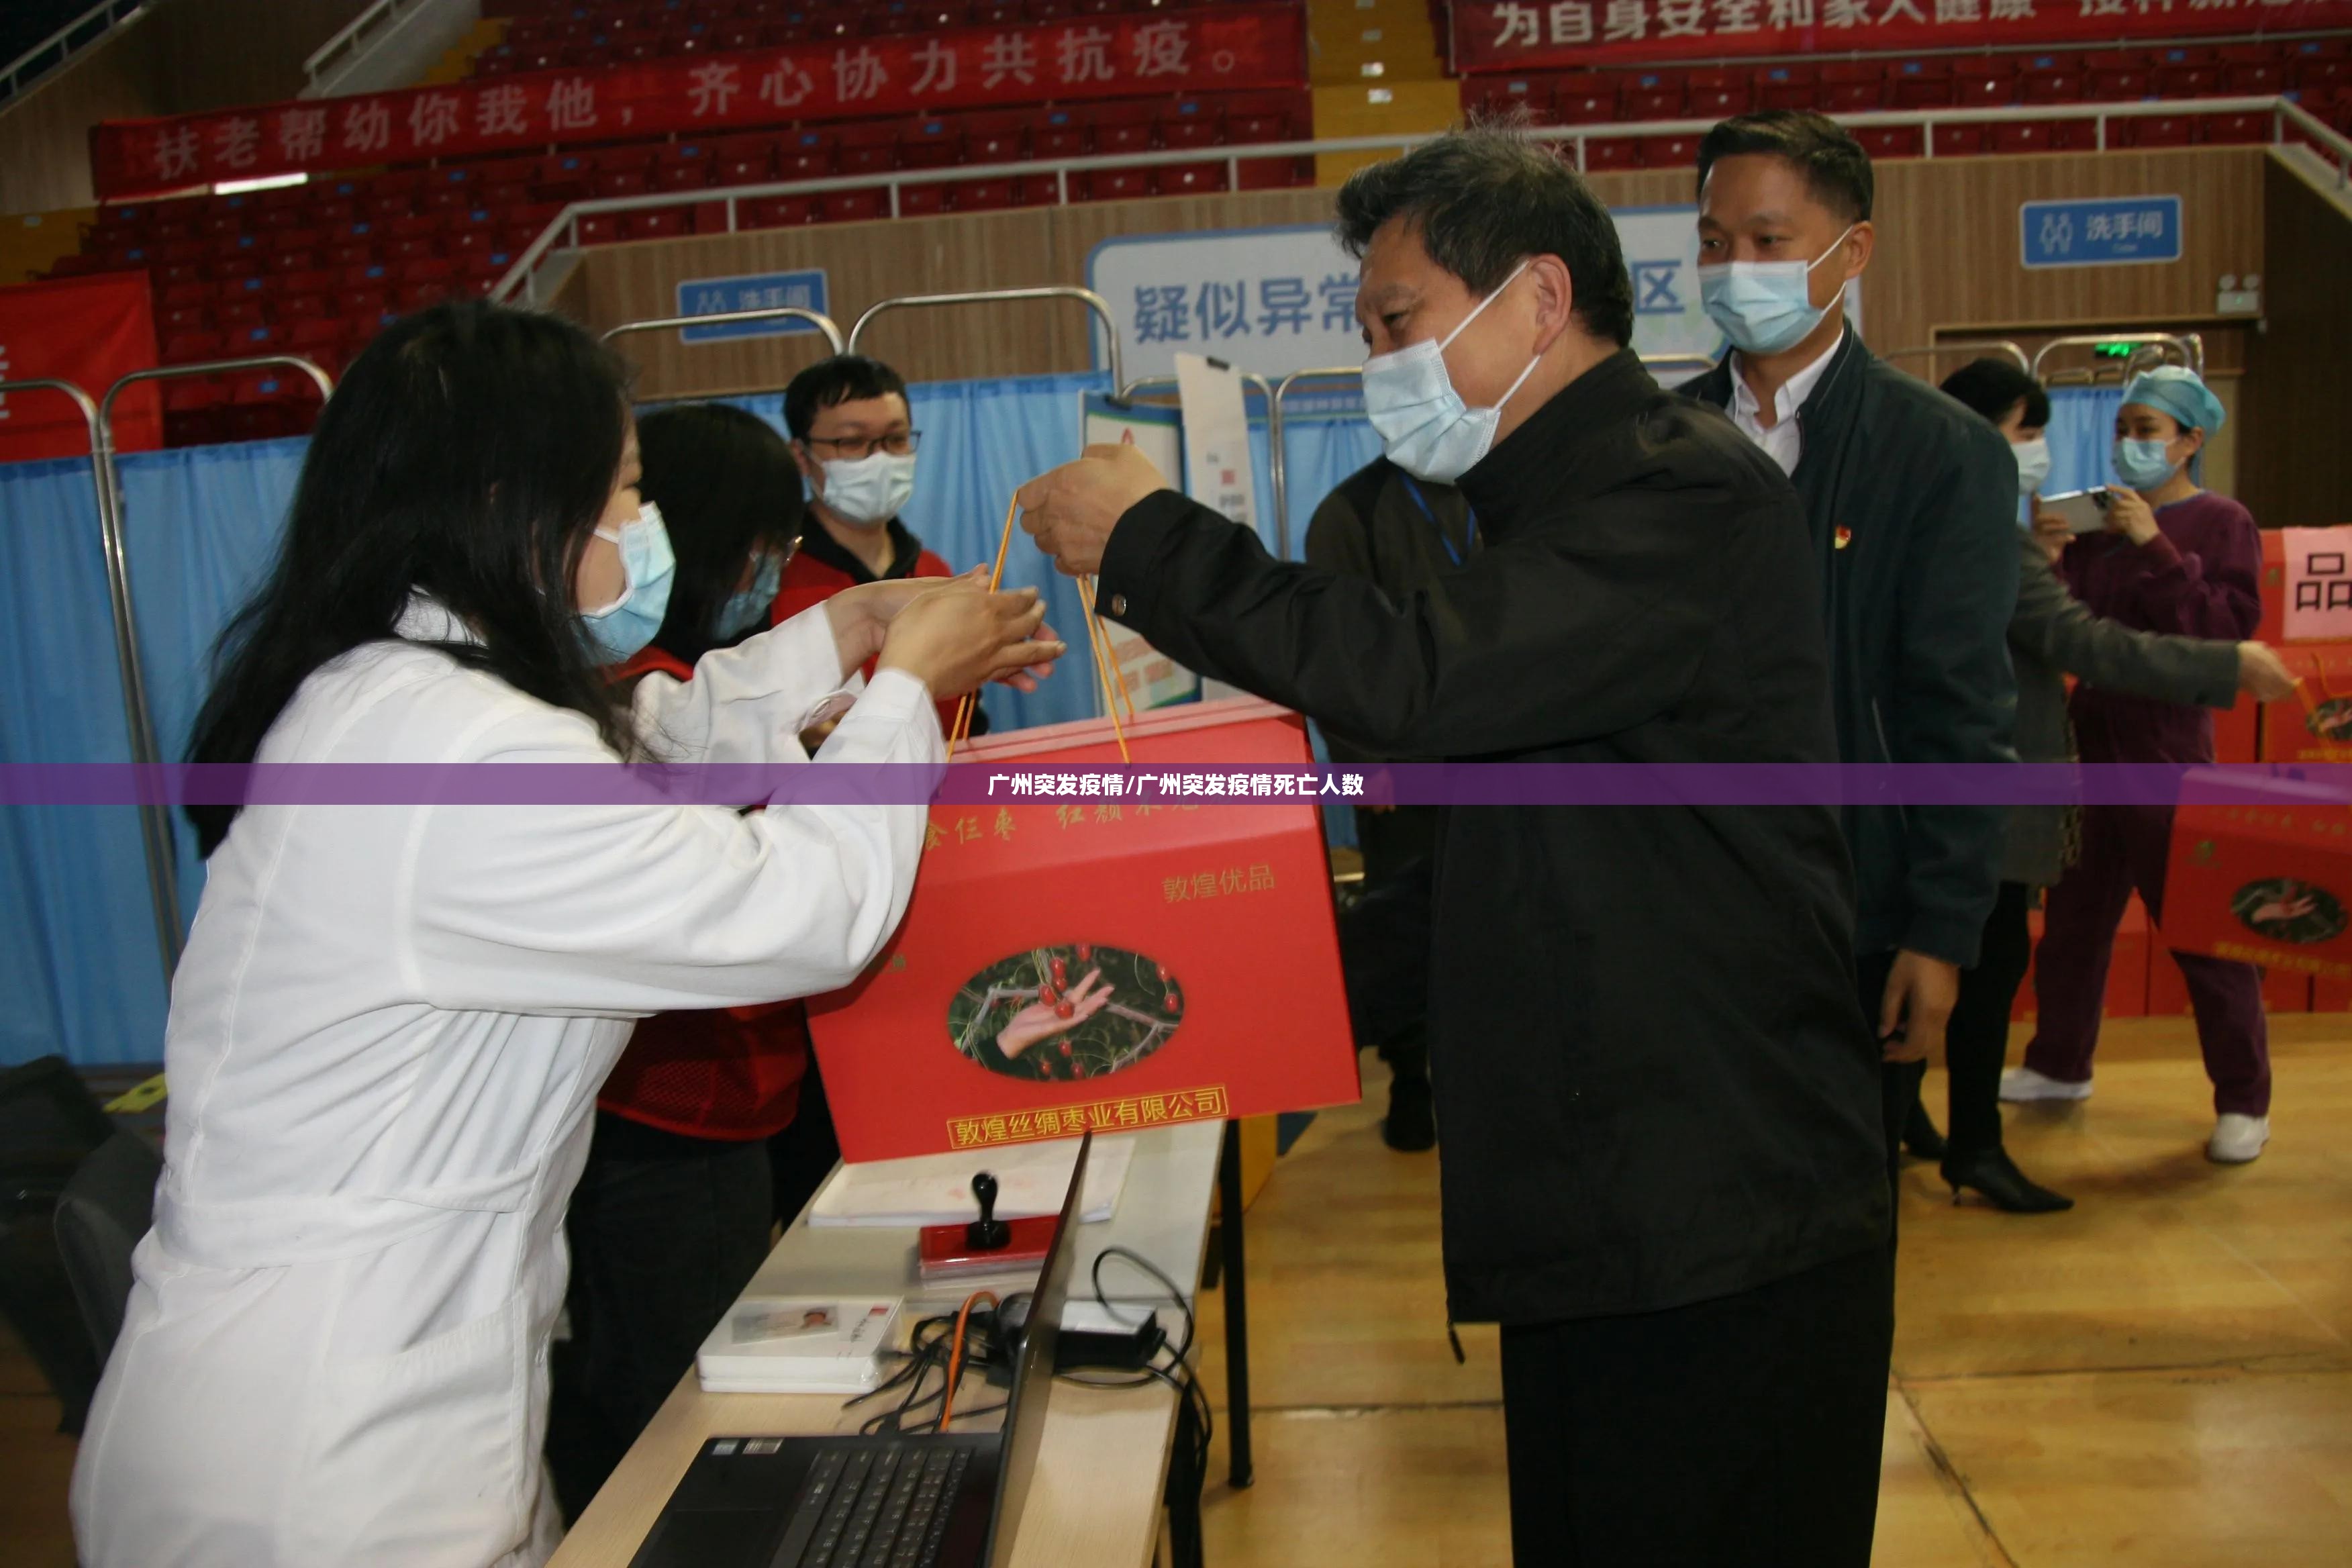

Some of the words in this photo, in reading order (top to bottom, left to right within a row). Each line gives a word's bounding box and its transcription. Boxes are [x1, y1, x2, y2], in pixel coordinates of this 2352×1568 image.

[2086, 210, 2163, 240] 洗手间
[1134, 271, 1361, 344] 疑似异常
[1632, 259, 1685, 315] 区
[2296, 552, 2352, 611] 品
[1161, 863, 1275, 903] 敦煌优品
[955, 1088, 1222, 1145] 敦煌丝绸枣业有限公司
